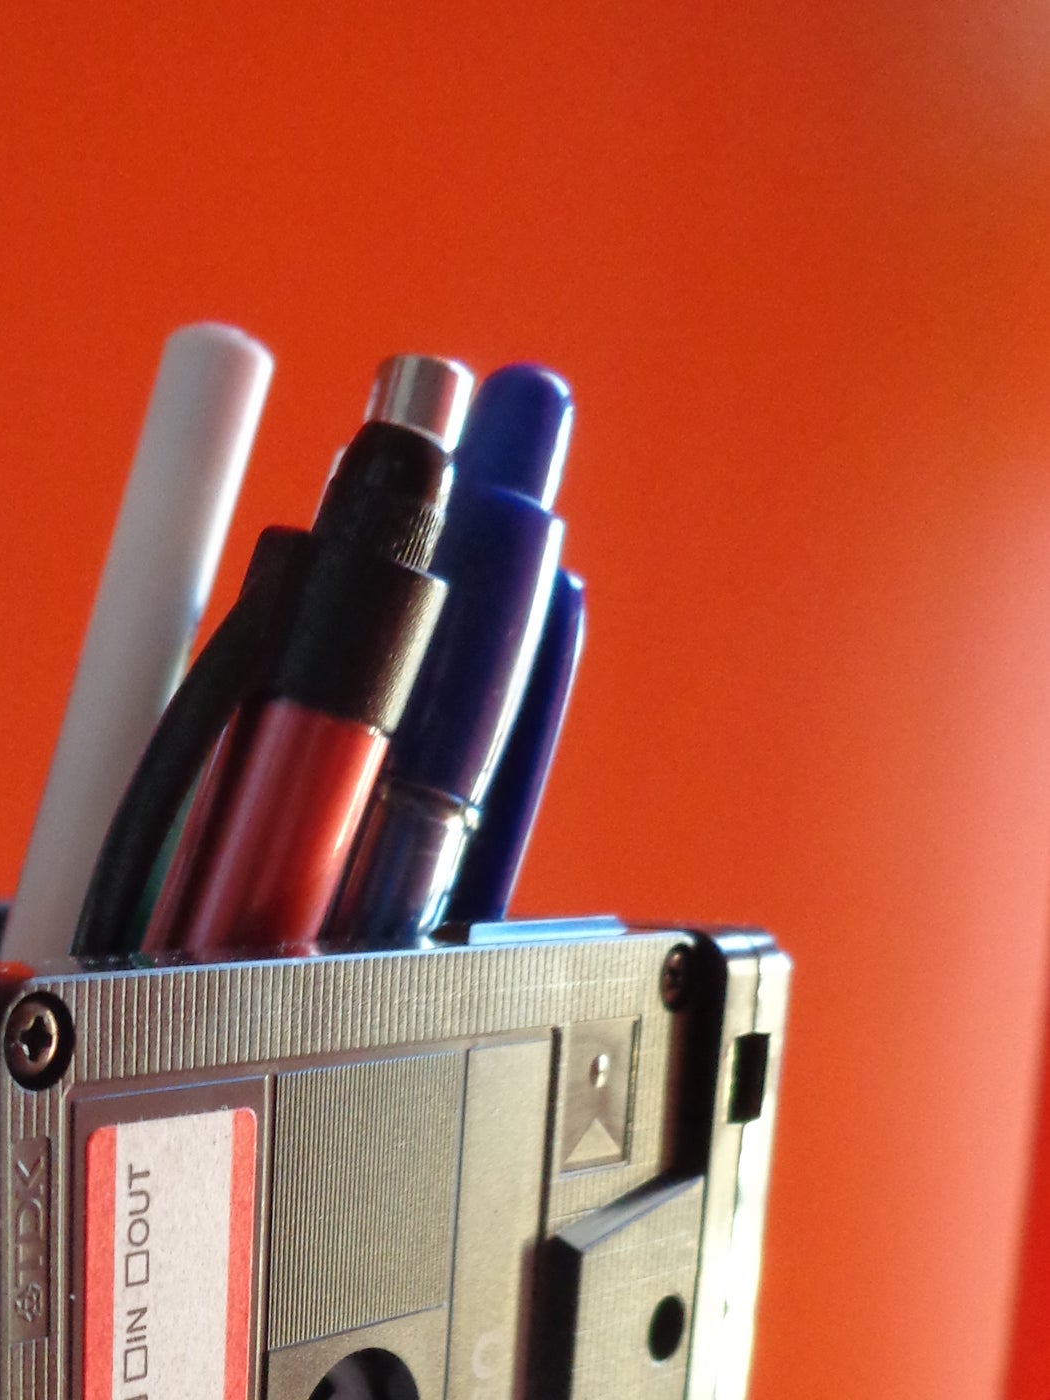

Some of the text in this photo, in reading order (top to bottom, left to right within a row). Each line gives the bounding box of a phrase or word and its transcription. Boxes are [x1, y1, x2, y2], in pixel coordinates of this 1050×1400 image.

[14, 1154, 46, 1290] TDK
[126, 1162, 151, 1248] OUT
[126, 1306, 148, 1344] IN
